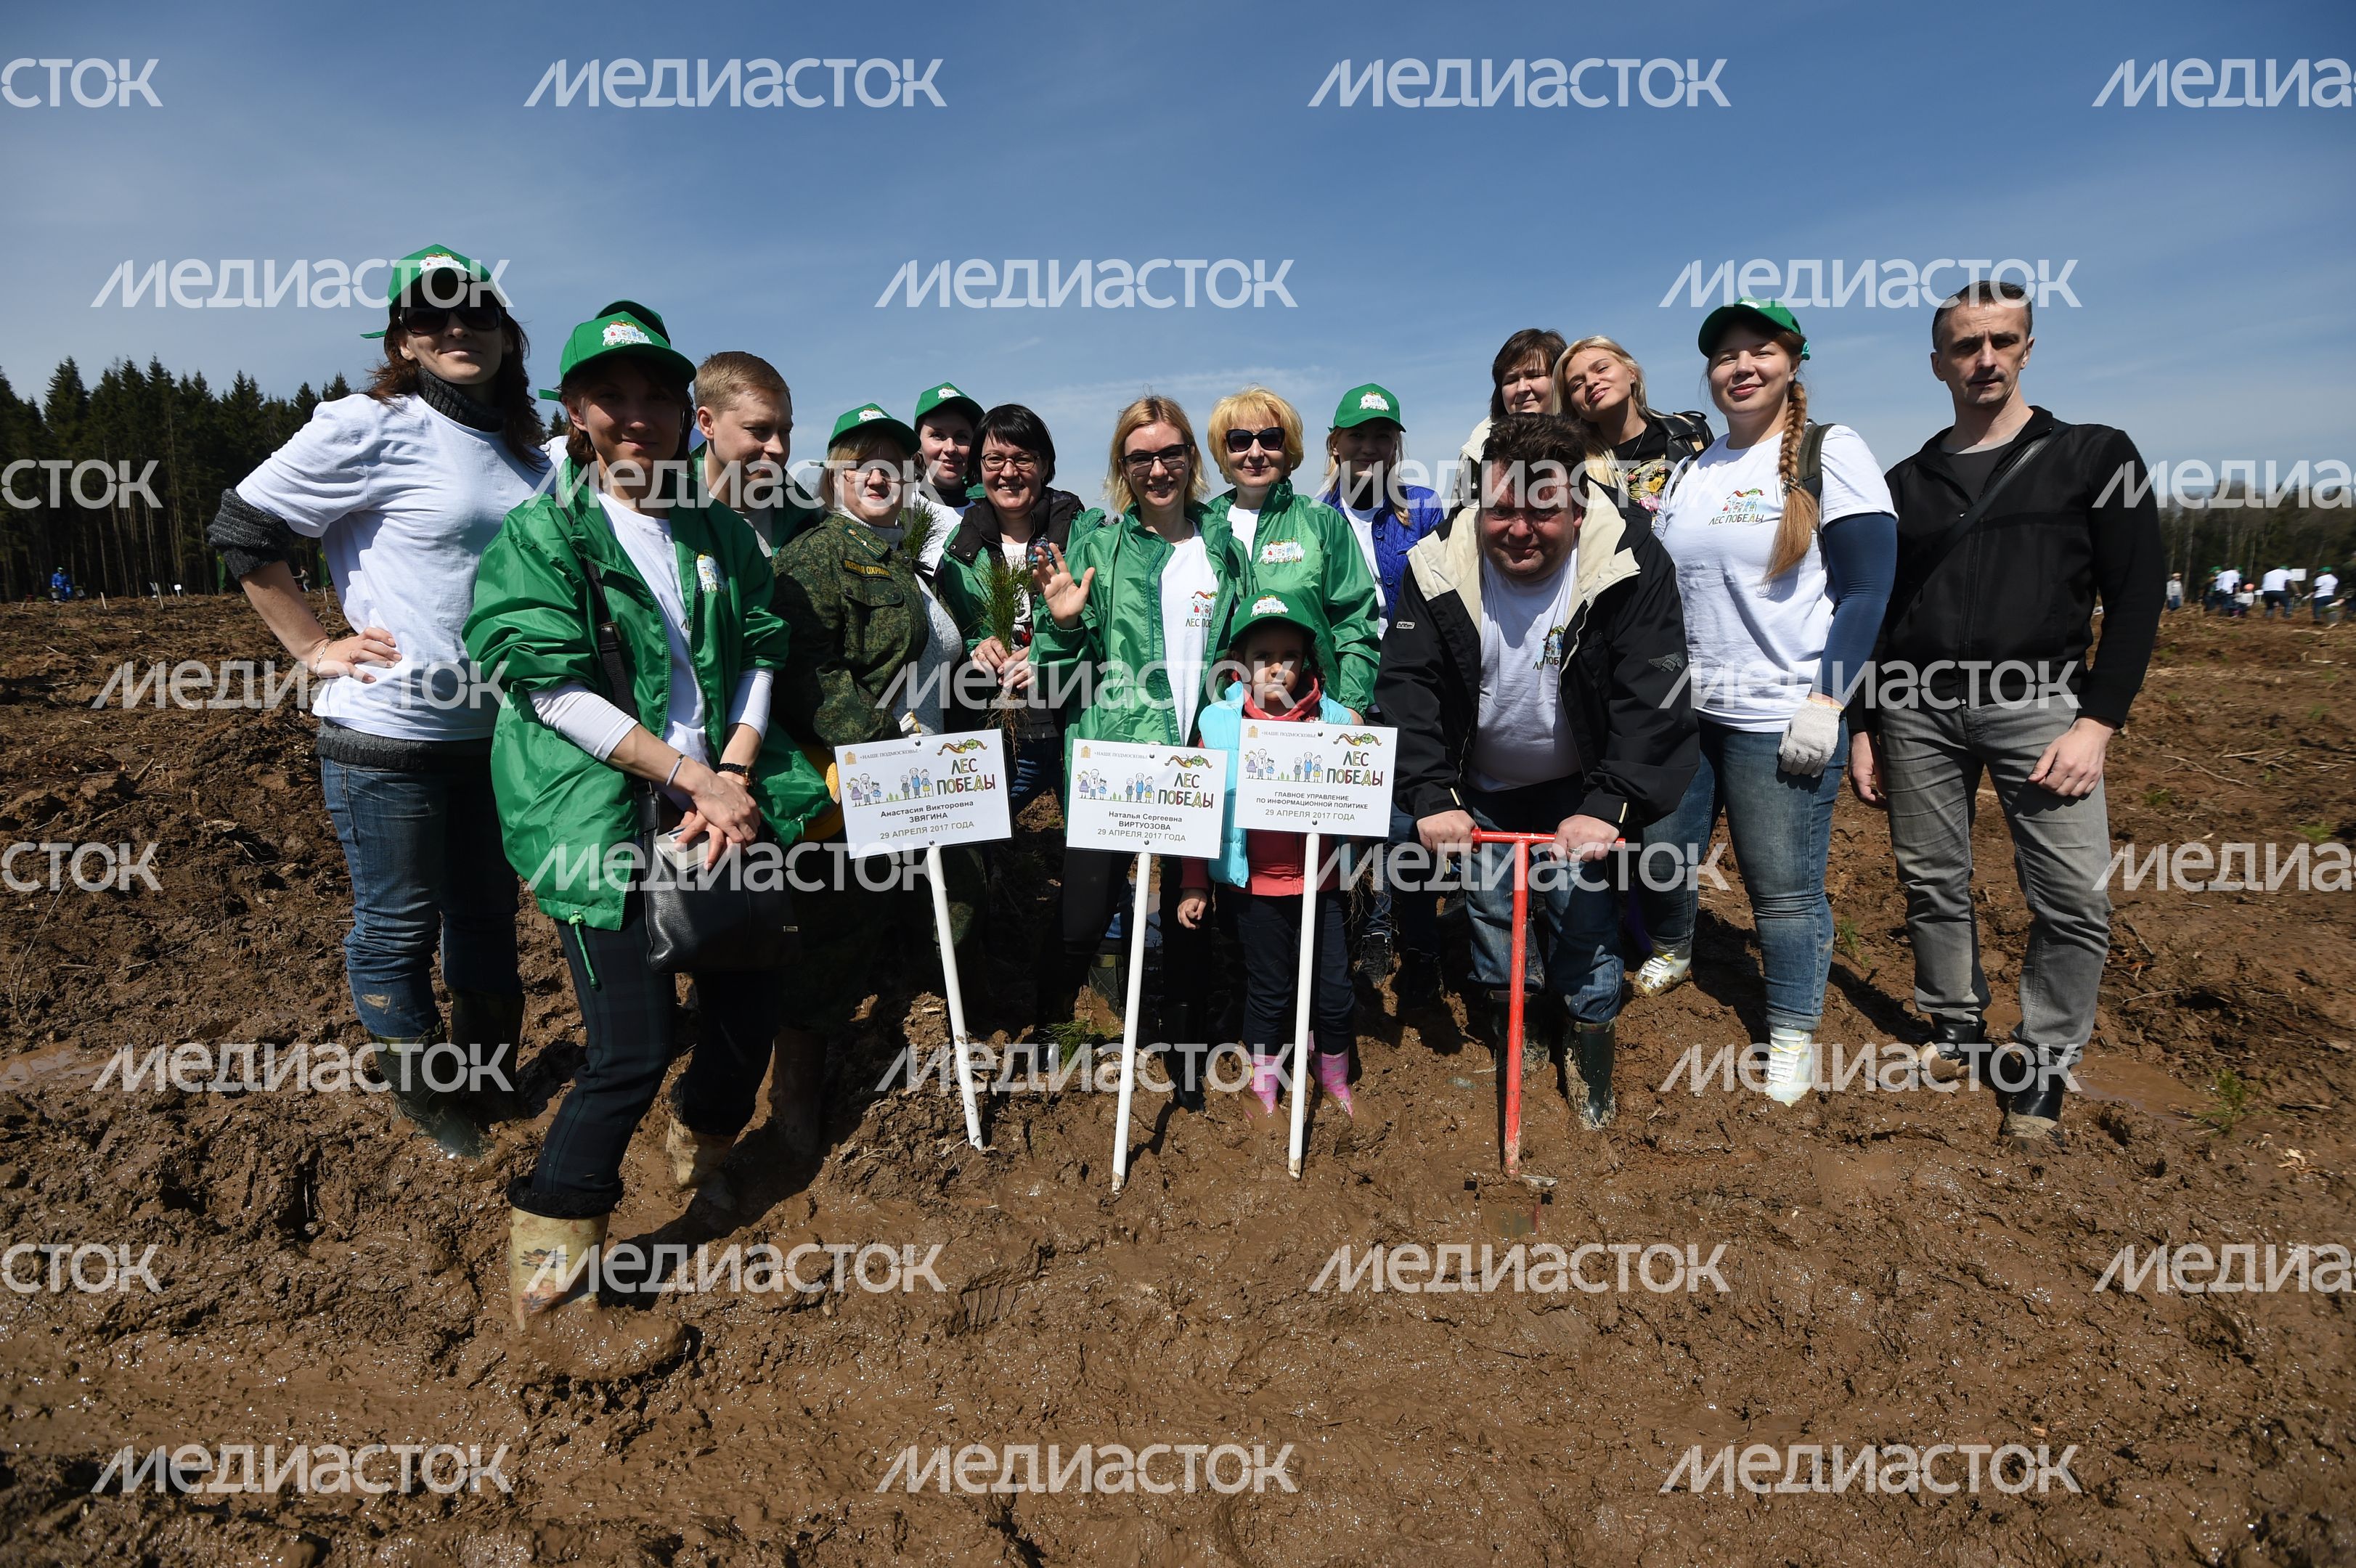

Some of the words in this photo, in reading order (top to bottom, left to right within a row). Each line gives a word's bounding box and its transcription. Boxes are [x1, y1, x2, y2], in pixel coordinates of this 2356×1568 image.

[1708, 515, 1725, 526] ЛЕС
[1725, 513, 1764, 523] ПОБЕДЫ
[1185, 618, 1199, 627] ЛЕС
[1201, 618, 1212, 628] ПОБ
[1544, 655, 1560, 665] ПОБ
[1342, 751, 1369, 767] ЛЕС
[951, 758, 978, 775] ЛЕС
[1173, 772, 1201, 788] ЛЕС
[1326, 768, 1384, 787] ПОБЕДЫ
[937, 774, 996, 796] ПОБЕДЫ
[1157, 789, 1214, 809] ПОБЕДЫ
[1268, 799, 1333, 808] ИНФОРМАЦИОННОЙ
[1307, 793, 1349, 801] УПРАВЛЕНИЕ
[880, 806, 924, 817] Анастасия
[926, 800, 974, 812] Викторовна
[909, 812, 948, 823] ЗВЯГИНА
[1109, 810, 1140, 820] Наталья
[1143, 813, 1182, 822] Сергеевна
[892, 827, 928, 838] АПРЕЛЯ
[930, 824, 948, 833] 2017
[951, 820, 974, 830] ГОДА
[1118, 820, 1171, 830] ВИРТУОЗОВА
[1164, 833, 1186, 842] ГОДА
